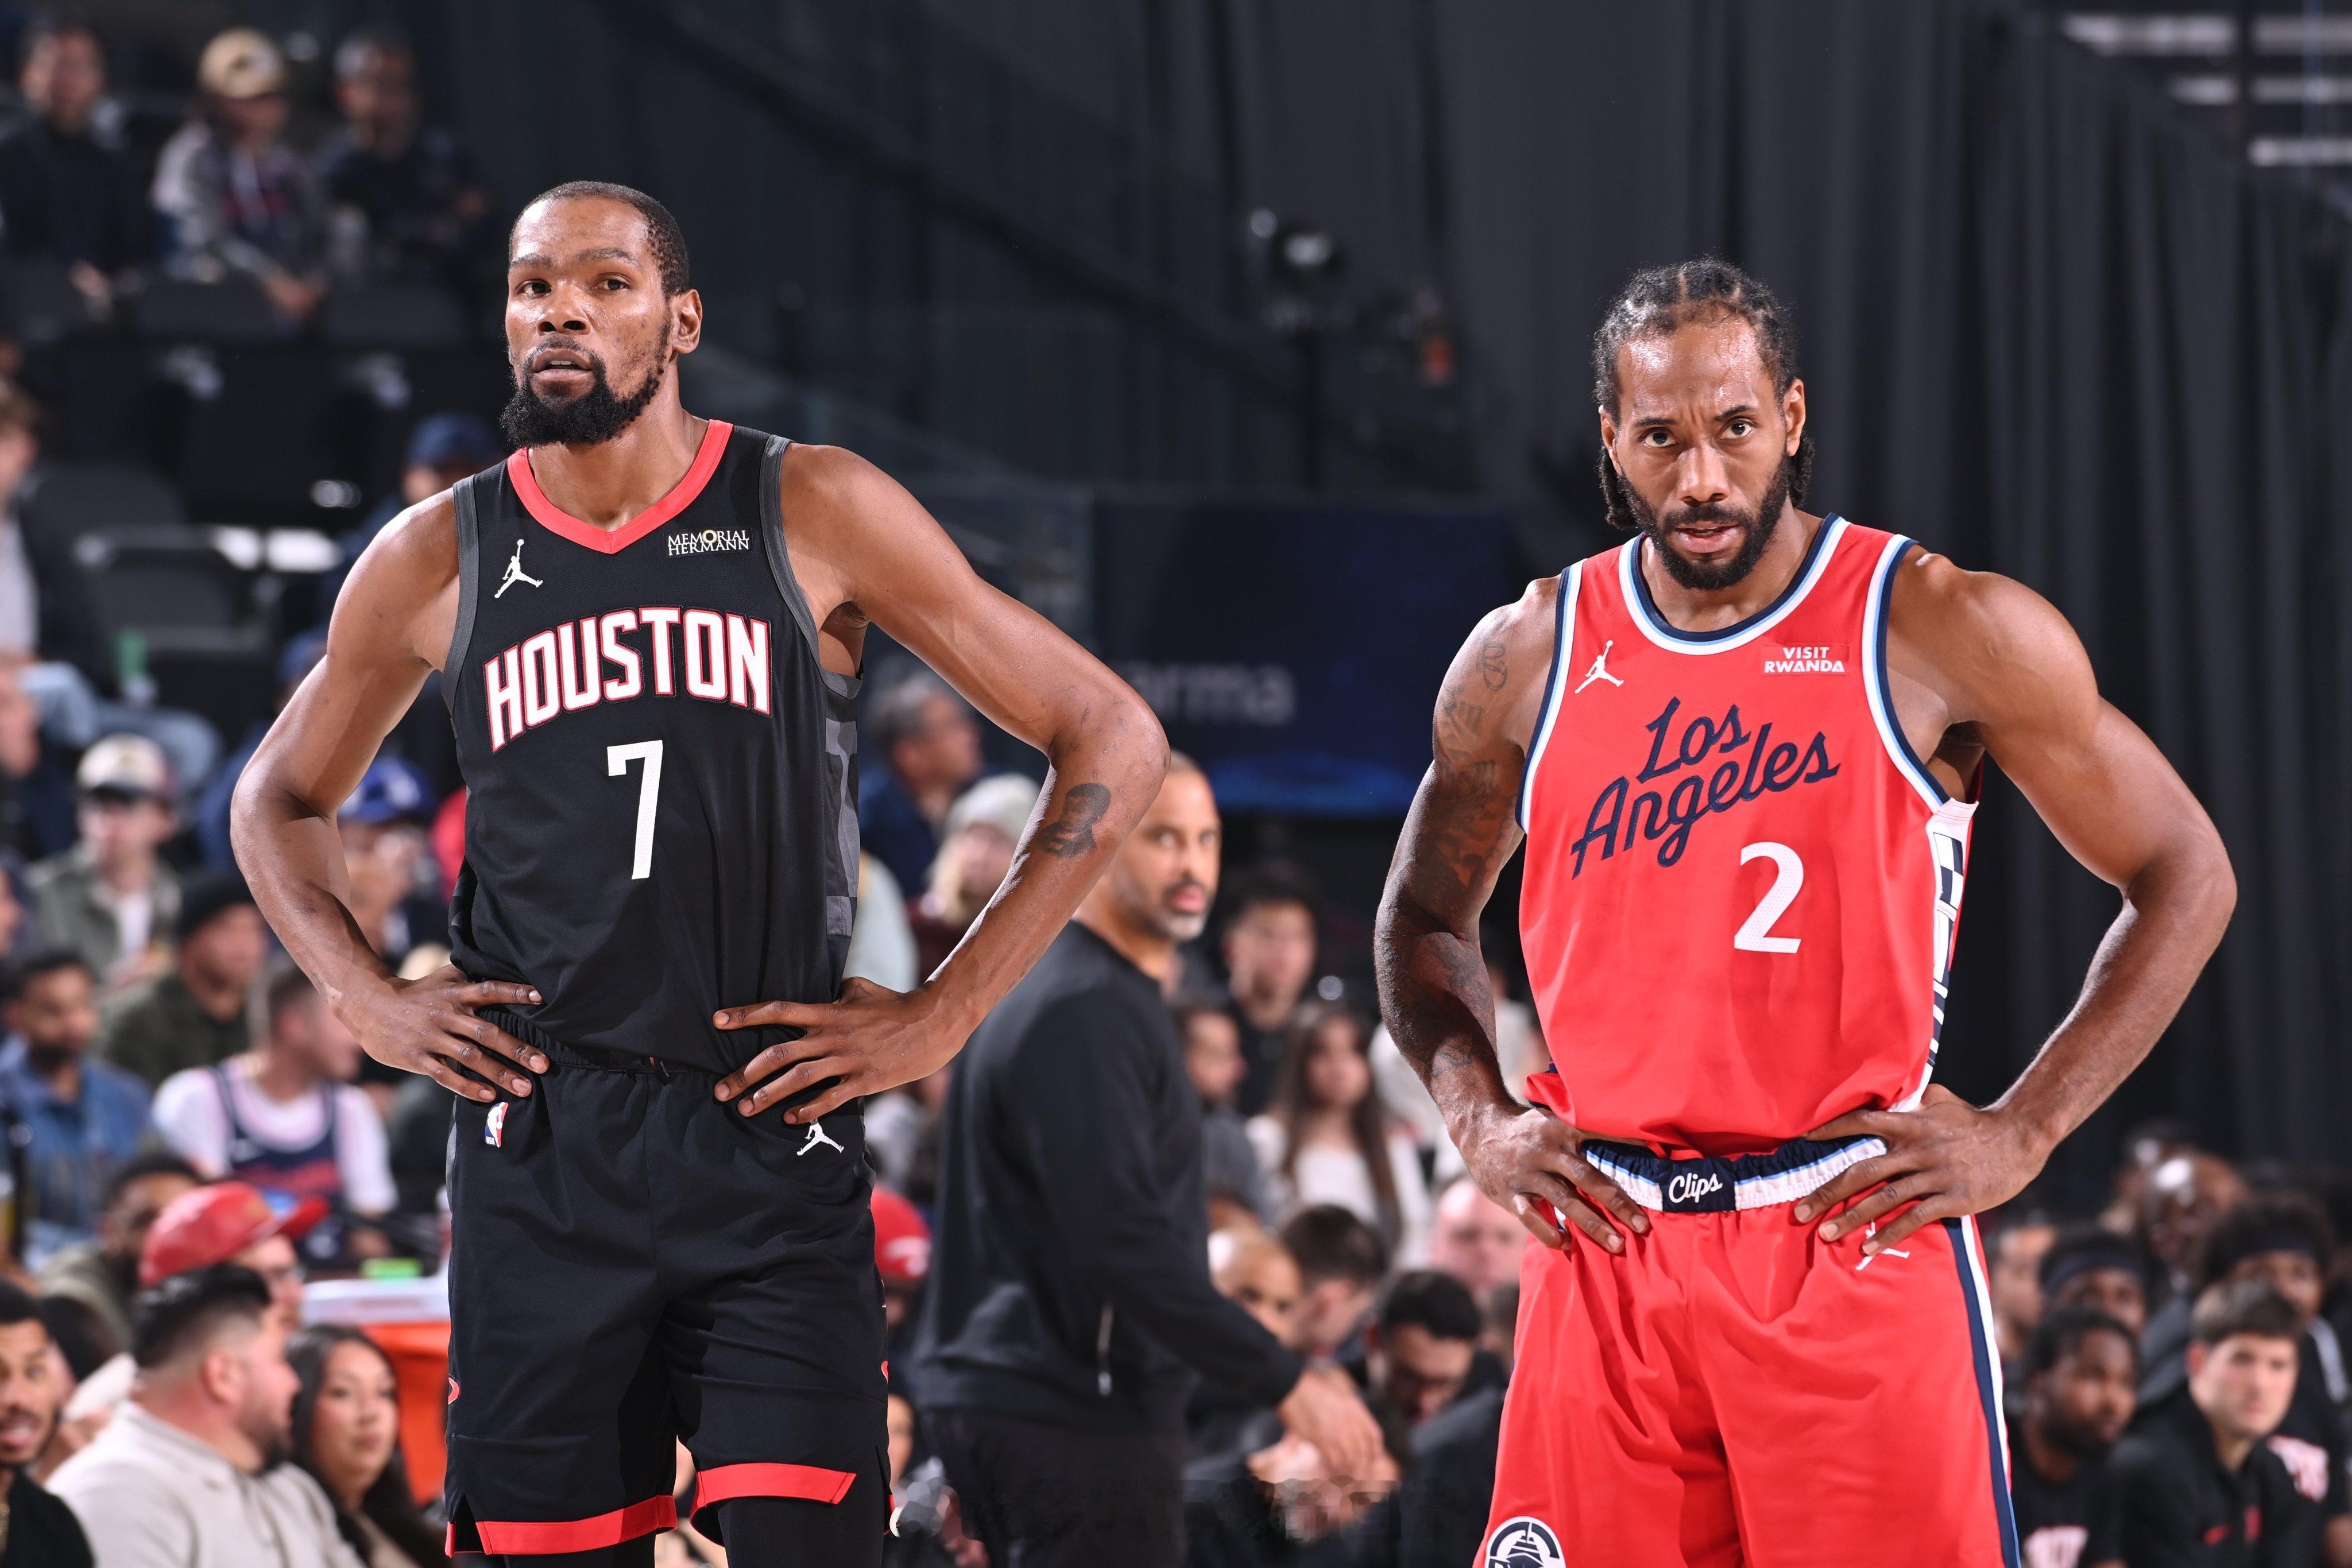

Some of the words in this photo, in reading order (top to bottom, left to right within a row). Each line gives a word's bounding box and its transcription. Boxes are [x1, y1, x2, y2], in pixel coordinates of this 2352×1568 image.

[668, 529, 749, 547] MEMORIAL
[668, 539, 749, 556] HERMANN
[484, 607, 771, 753] HOUSTON
[1764, 660, 1845, 673] RWANDA
[1782, 646, 1829, 659] VISIT
[1637, 696, 1751, 784] Los
[607, 740, 663, 880] 7
[1571, 723, 1841, 880] Angeles
[1734, 842, 1804, 954] 2
[1668, 1172, 1723, 1203] Clips
